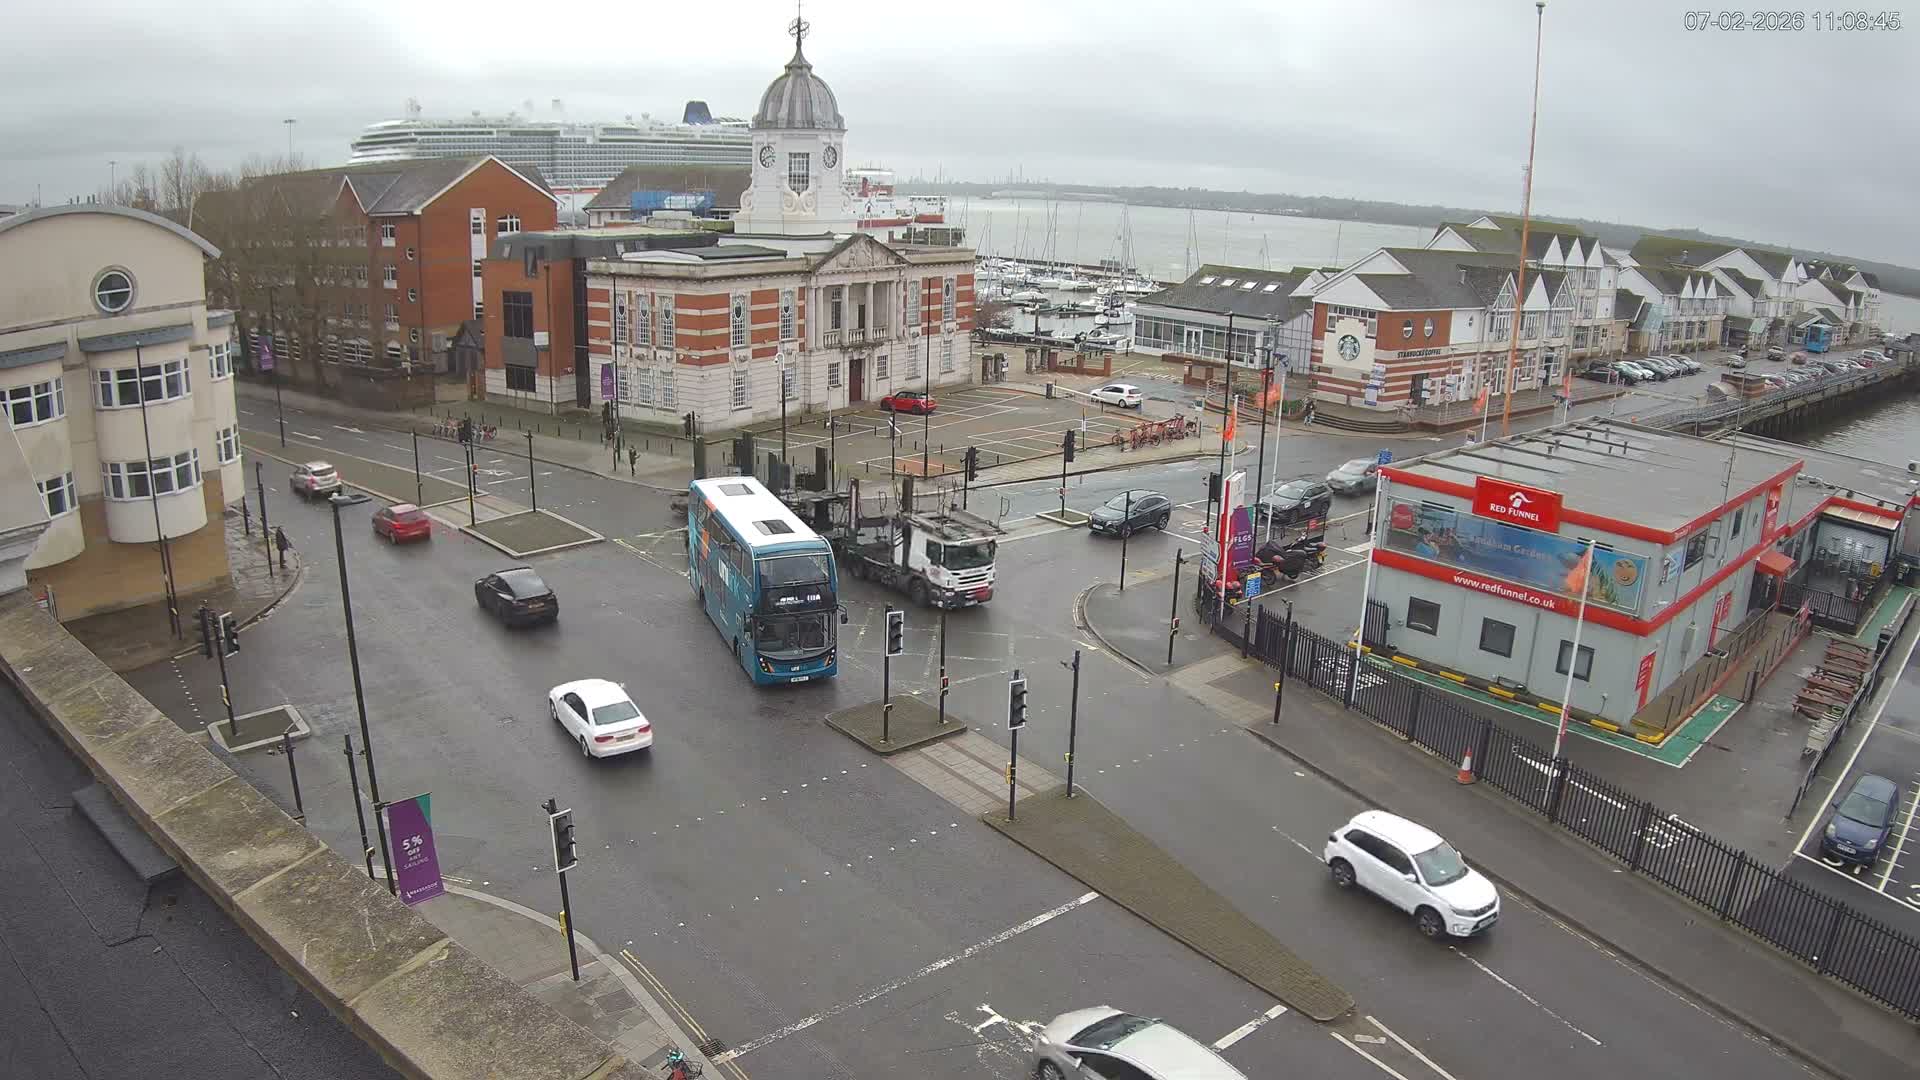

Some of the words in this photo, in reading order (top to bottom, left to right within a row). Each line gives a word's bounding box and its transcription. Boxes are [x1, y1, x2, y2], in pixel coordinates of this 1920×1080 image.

[1490, 503, 1506, 514] RED
[1508, 507, 1540, 522] FUNNEL
[1453, 575, 1556, 609] www.redfunnel.co.uk
[407, 847, 420, 856] OFF
[403, 857, 429, 870] SAILING
